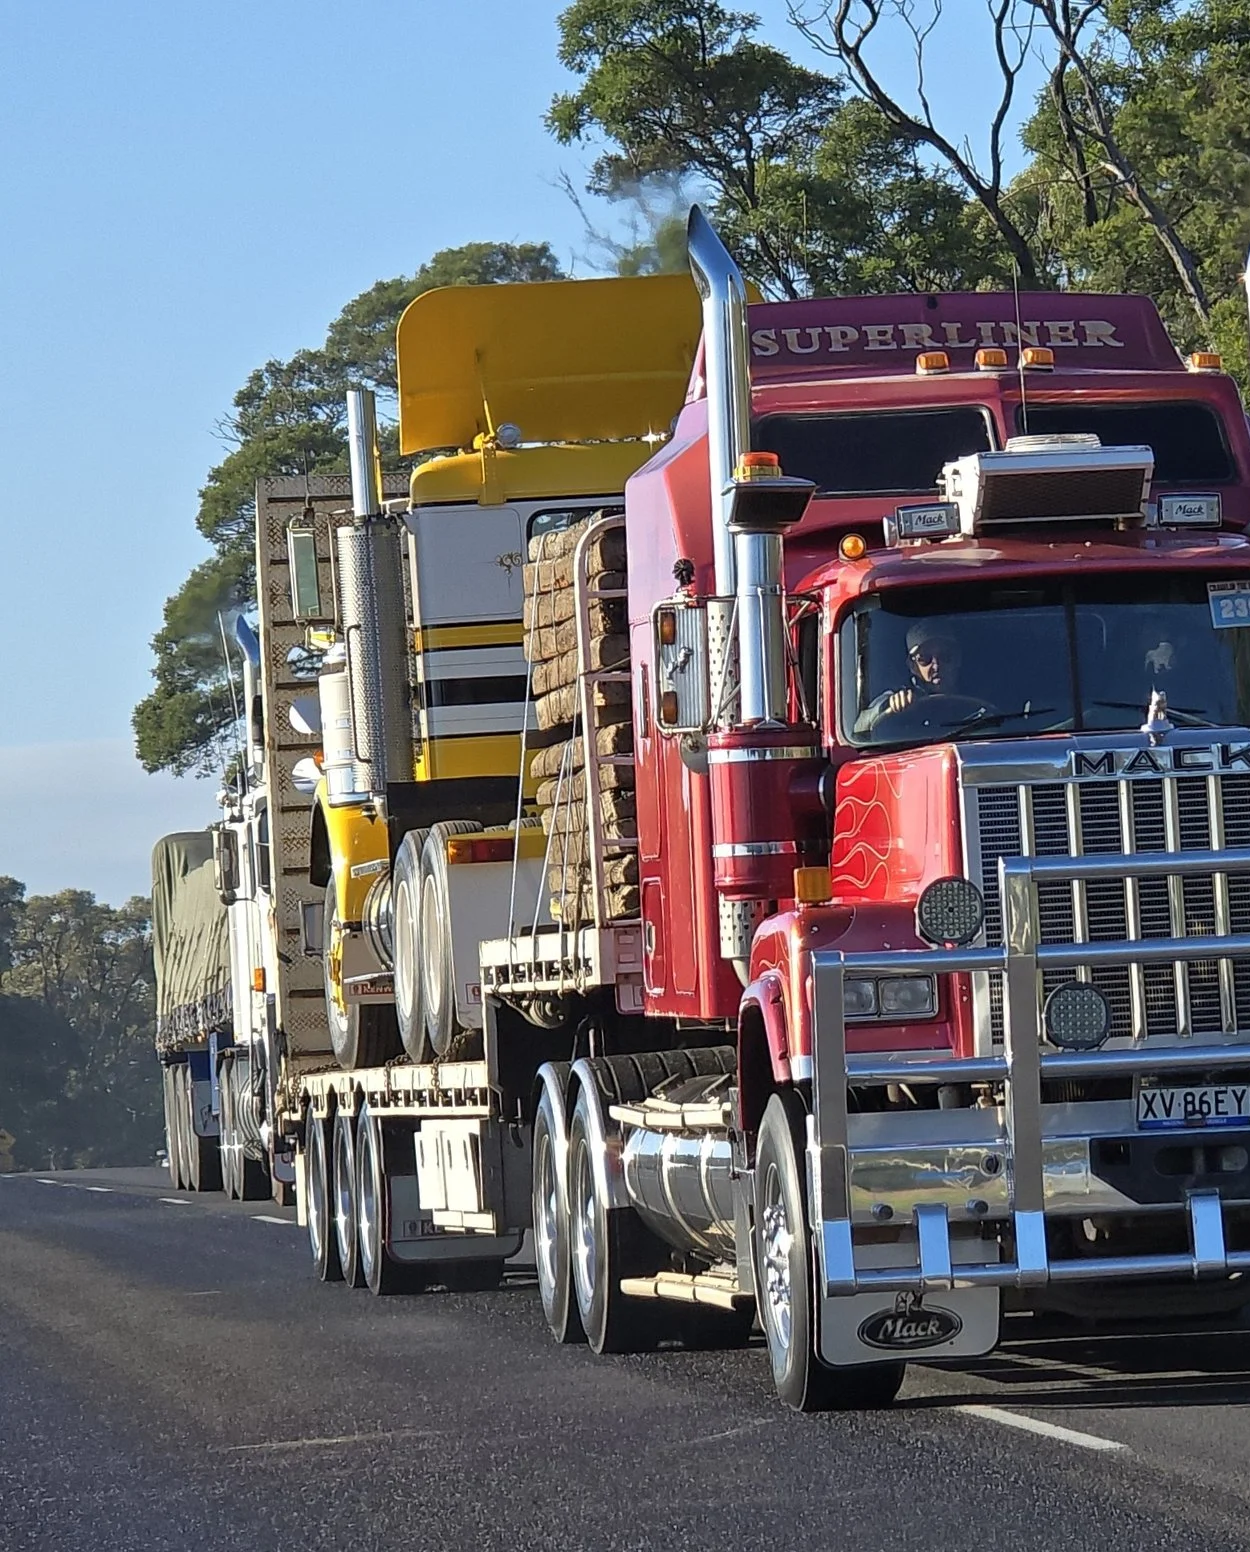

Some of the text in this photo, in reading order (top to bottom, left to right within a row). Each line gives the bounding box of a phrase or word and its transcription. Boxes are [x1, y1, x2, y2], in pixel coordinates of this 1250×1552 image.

[750, 320, 1125, 357] SUPERLINER
[914, 512, 945, 527] Mack
[1175, 504, 1205, 517] Mack
[878, 1315, 943, 1341] Mack
